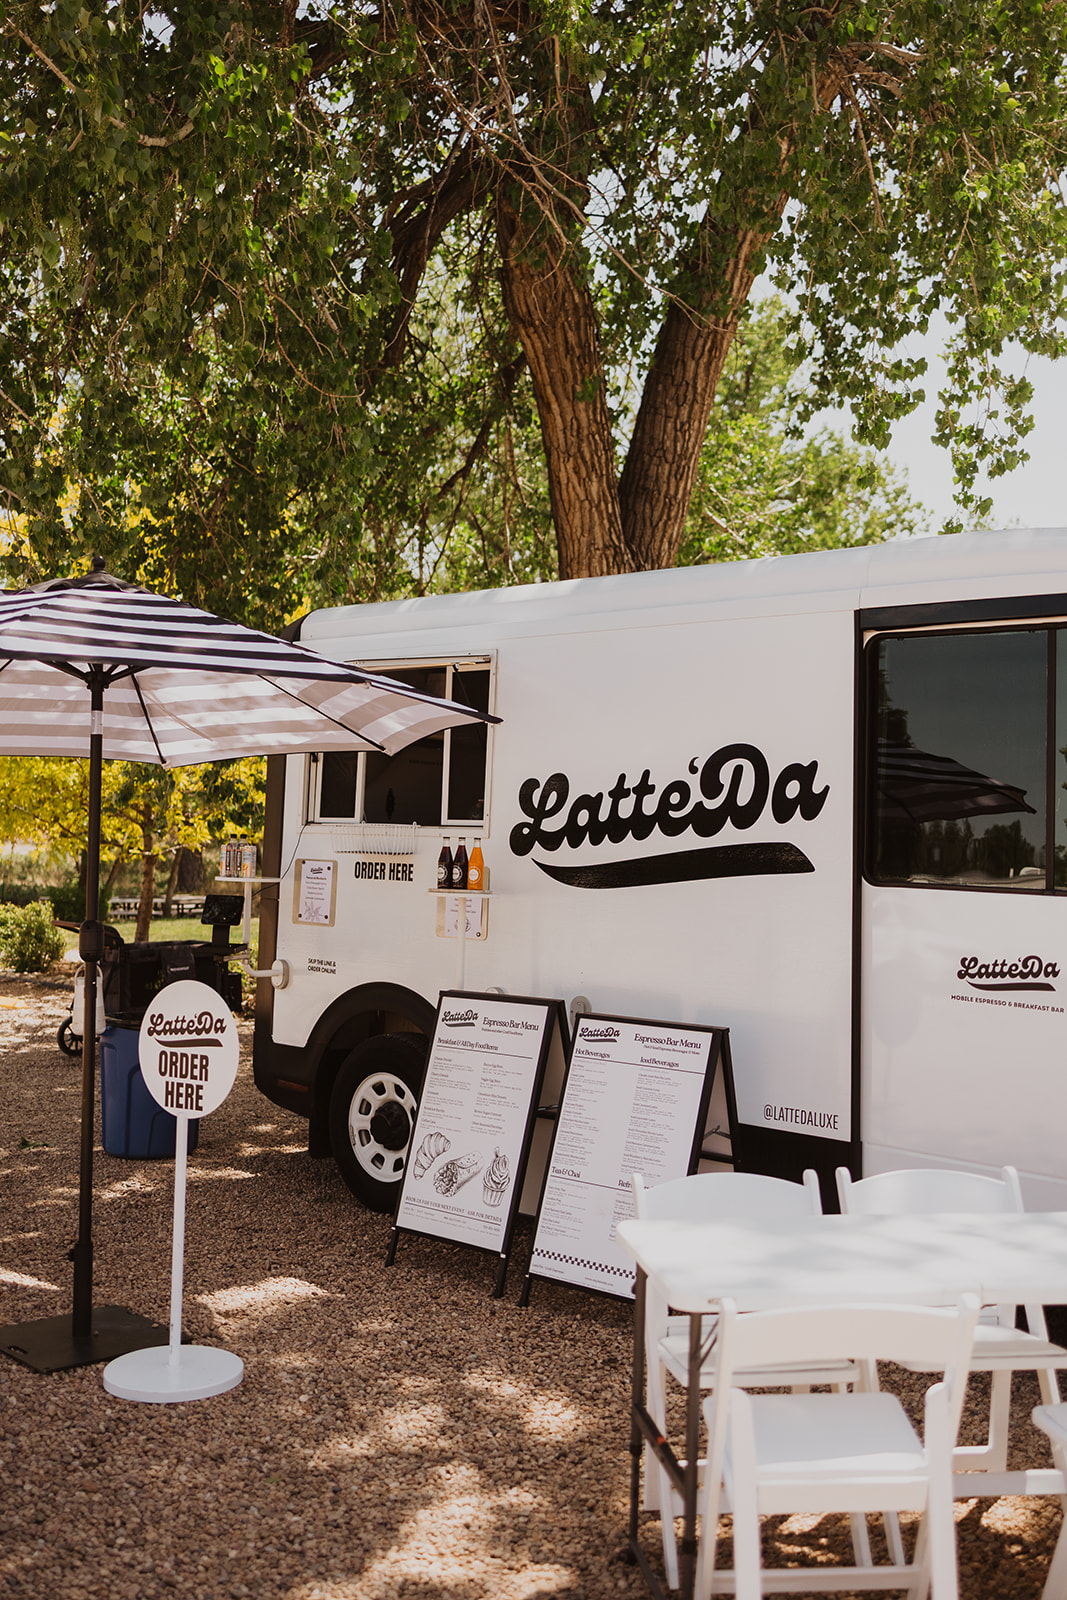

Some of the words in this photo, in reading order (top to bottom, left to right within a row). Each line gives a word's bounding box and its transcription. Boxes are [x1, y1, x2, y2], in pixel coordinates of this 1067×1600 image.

[354, 861, 386, 881] ORDER
[388, 862, 414, 882] HERE
[308, 958, 316, 966] SKIP
[308, 966, 322, 974] ORDER
[322, 967, 336, 975] ONLINE
[975, 998, 1007, 1006] ESPRESSO
[1014, 1002, 1050, 1012] BREAKFAST
[483, 1017, 509, 1028] Espresso
[509, 1020, 519, 1029] Bar
[520, 1021, 539, 1031] Menu
[634, 1033, 666, 1044] Espresso
[666, 1037, 679, 1046] Bar
[679, 1039, 701, 1049] Menu
[585, 1049, 610, 1058] Beverages
[158, 1050, 210, 1082] ORDER
[652, 1058, 679, 1067] Beverages
[164, 1080, 204, 1112] HERE
[764, 1104, 838, 1130] @LATTEDALUXE
[552, 1166, 561, 1174] Tea
[568, 1170, 580, 1178] Chai
